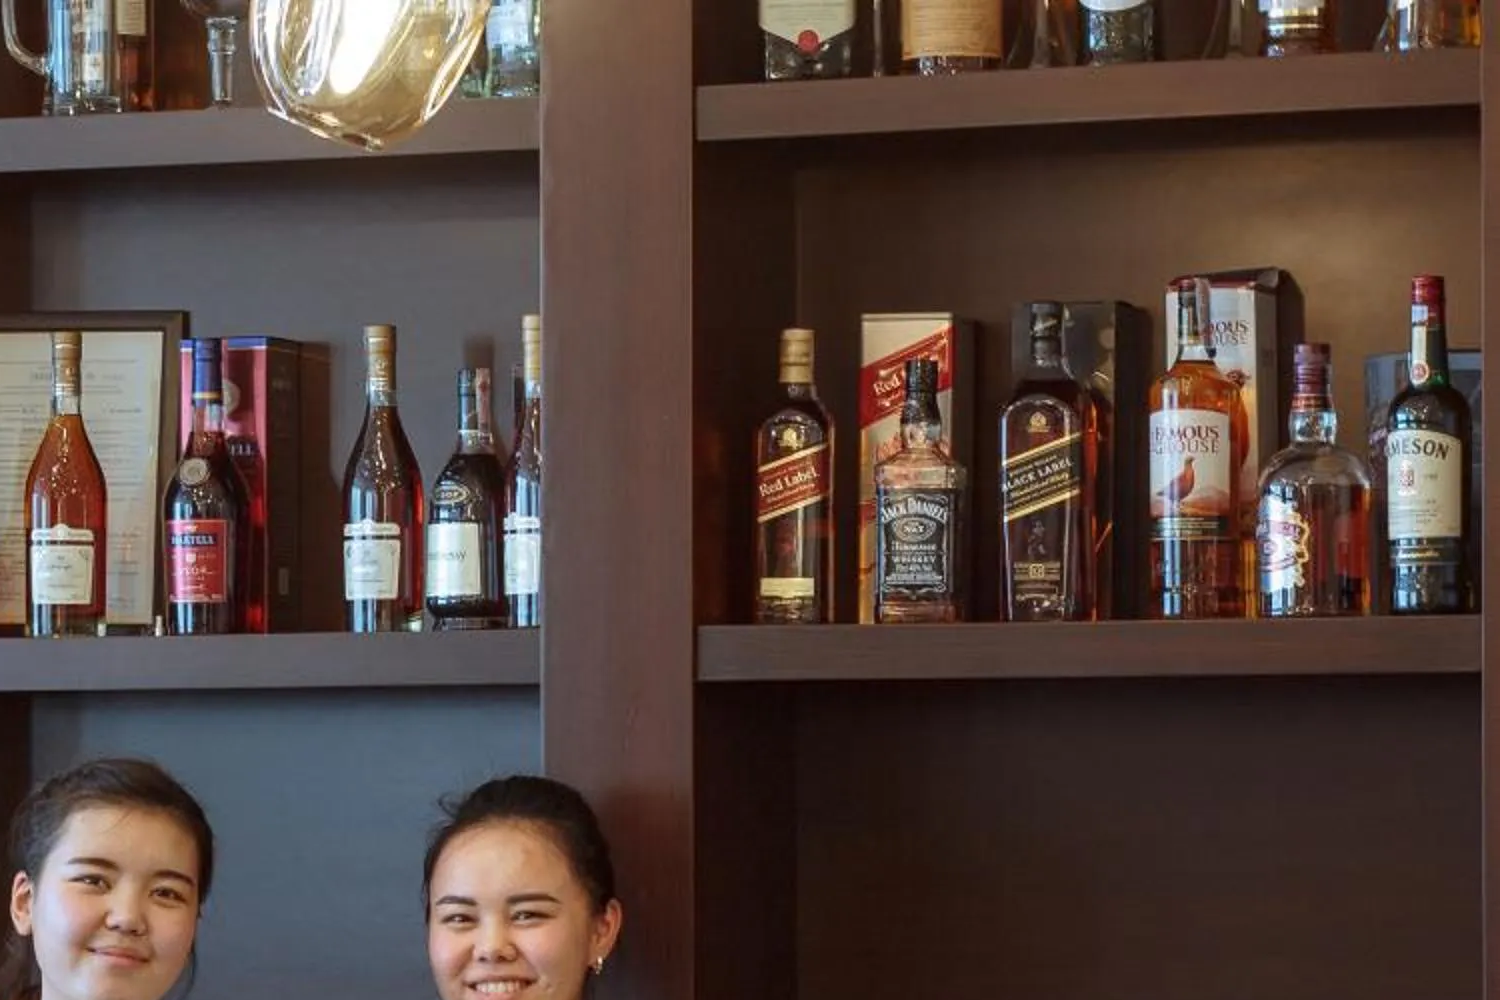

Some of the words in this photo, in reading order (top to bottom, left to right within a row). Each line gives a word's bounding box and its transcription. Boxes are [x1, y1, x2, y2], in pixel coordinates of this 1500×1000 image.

[1038, 456, 1073, 478] LABEL
[759, 478, 783, 497] Red
[786, 468, 819, 489] Label
